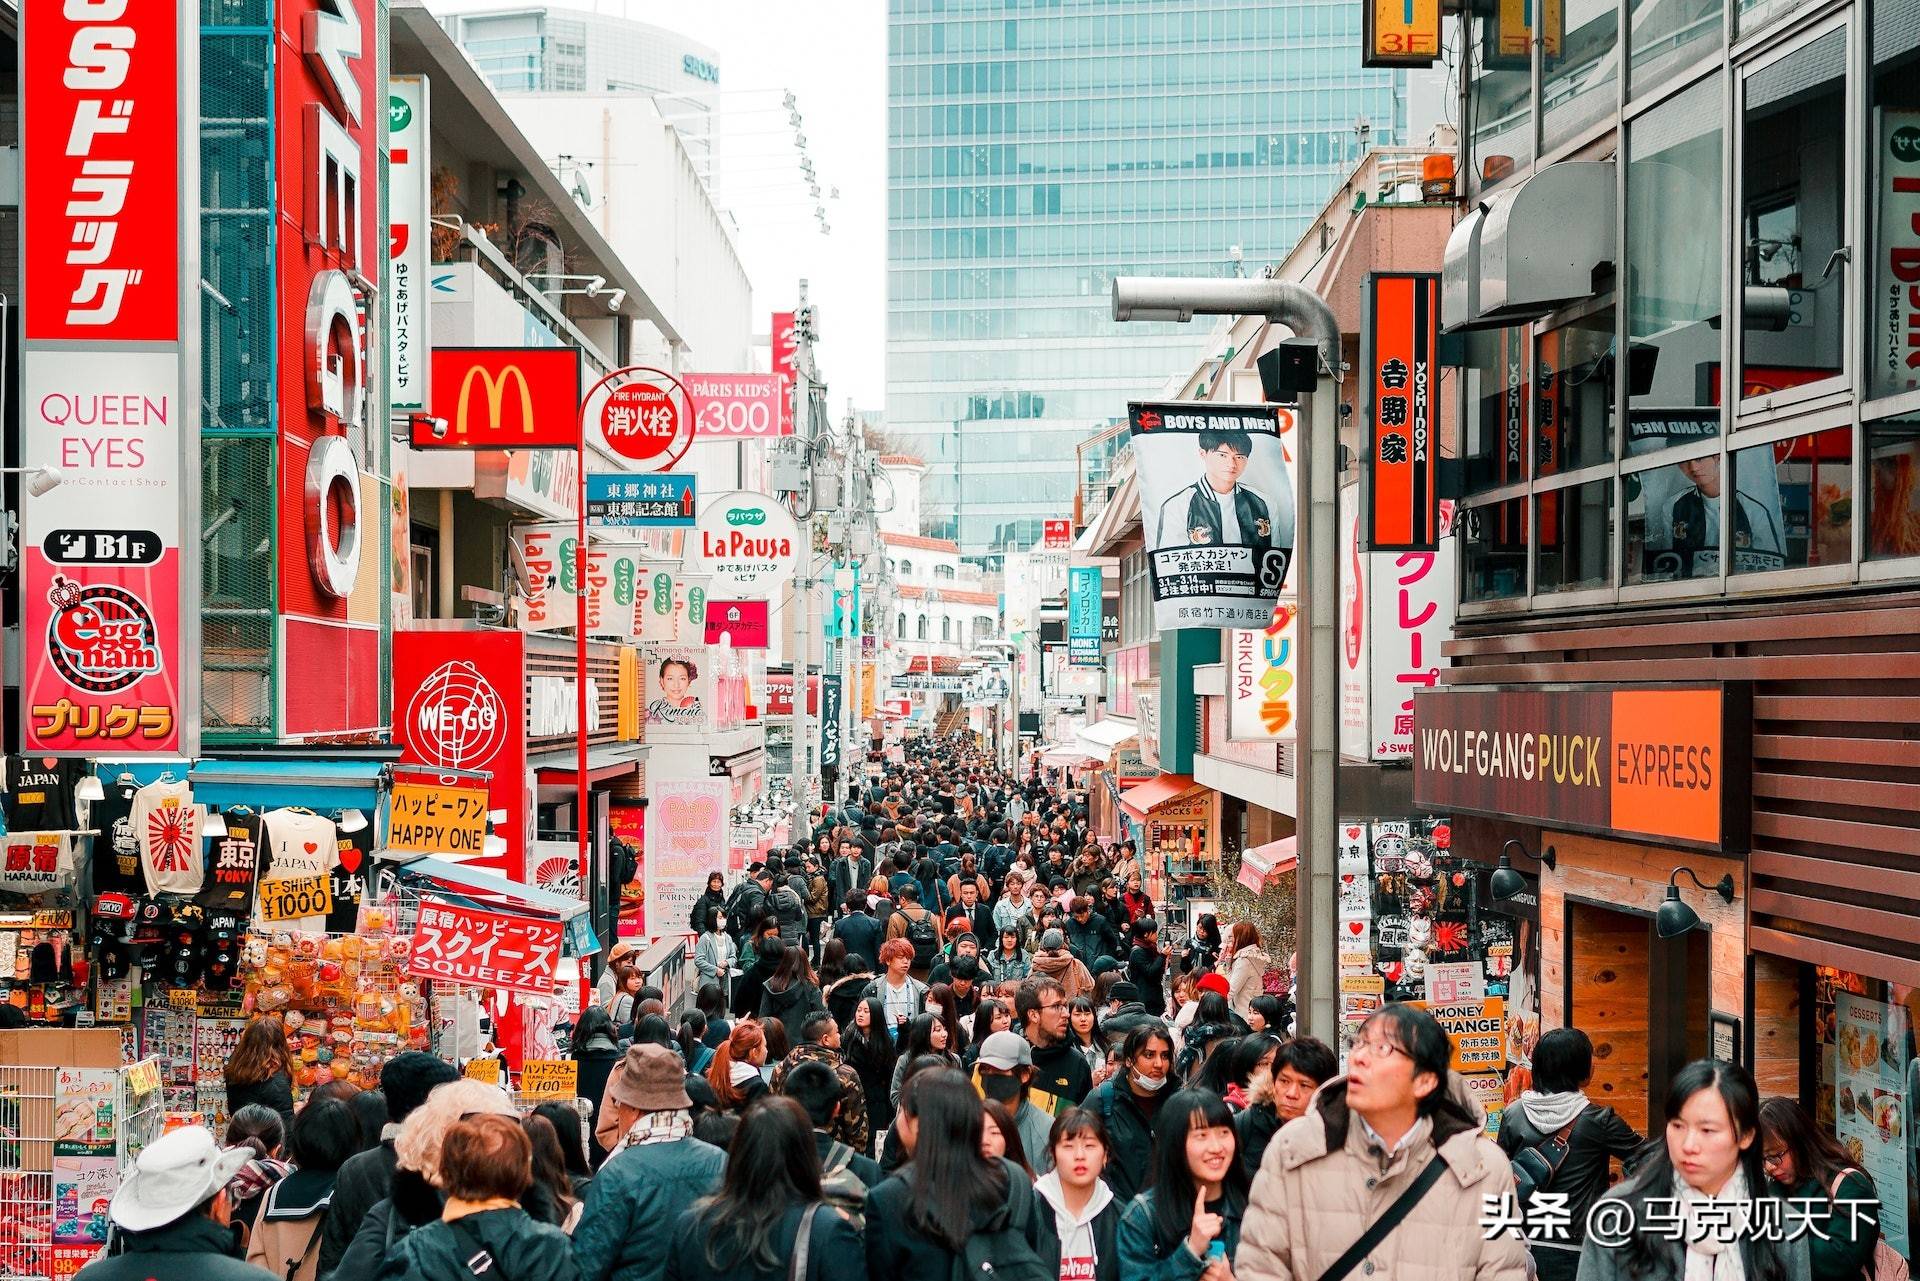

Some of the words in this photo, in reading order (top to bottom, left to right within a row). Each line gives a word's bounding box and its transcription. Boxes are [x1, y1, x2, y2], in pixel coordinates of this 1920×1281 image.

[1381, 33, 1434, 53] 3F
[614, 392, 630, 401] FIRE
[632, 392, 666, 401] HYDRANT
[693, 383, 731, 398] PARIS
[735, 383, 771, 398] KID'S
[41, 393, 167, 426] QUEEN
[696, 400, 770, 433] ¥300
[1380, 358, 1409, 464] 吉野家
[607, 405, 673, 436] 消火栓
[1164, 415, 1206, 430] BOYS
[1208, 416, 1239, 430] AND
[1242, 417, 1276, 432] MEN
[61, 437, 145, 468] EYES
[606, 483, 675, 498] 東郷神社
[606, 502, 679, 517] 東郷記念館
[94, 534, 147, 559] B1F
[1160, 549, 1248, 564] コラボスカジャン
[1178, 561, 1232, 573] 発売決定!
[1159, 584, 1214, 597] 受注受付中!
[1178, 607, 1268, 620] 原宿竹下通り商店会
[58, 604, 145, 651] egg
[1071, 638, 1099, 648] MONEY
[81, 648, 156, 669] nam
[22, 760, 30, 771] I
[1617, 742, 1712, 791] EXPRESS
[18, 774, 60, 787] JAPAN
[393, 793, 484, 820] ハッピーワン
[1160, 807, 1191, 816] SOCKS
[391, 823, 445, 847] HAPPY
[449, 827, 482, 850] ONE
[216, 838, 256, 869] 東京
[280, 841, 288, 852] I
[5, 845, 59, 873] 原宿
[272, 856, 320, 871] JAPAN
[4, 873, 57, 882] HARAJUKU
[263, 877, 323, 896] T-SHIRT
[263, 889, 327, 919] ¥1000
[210, 916, 236, 929] JAPAN
[420, 907, 560, 944] 原宿ハッピーワン
[416, 927, 557, 976] スクイーズ
[412, 956, 552, 990] SQUEEZE
[1435, 1006, 1484, 1018] MONEY
[1849, 1004, 1883, 1025] DESSERTS
[1440, 1019, 1501, 1034] HANGE
[524, 1063, 577, 1074] ハンドスピナー
